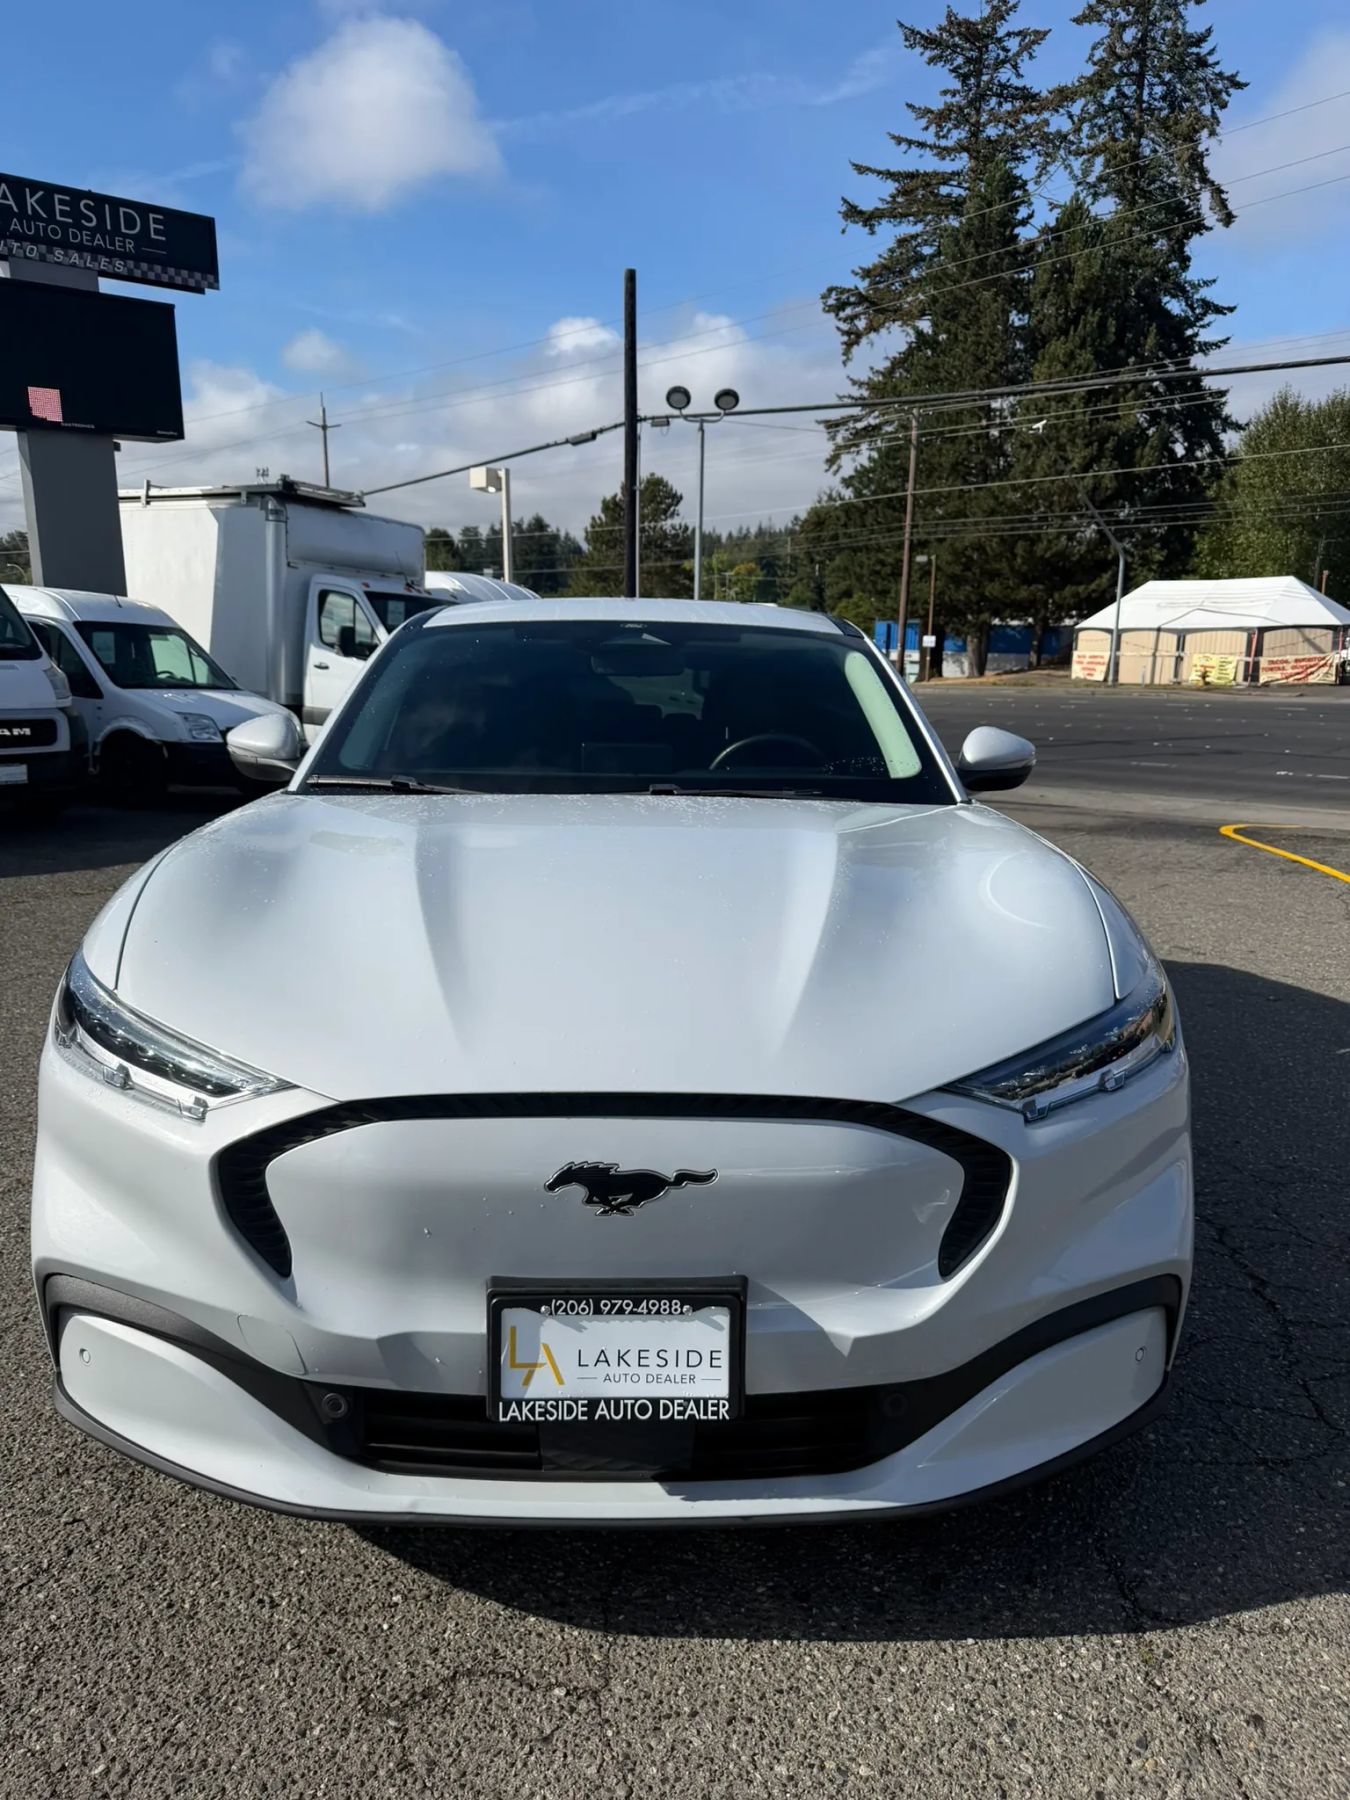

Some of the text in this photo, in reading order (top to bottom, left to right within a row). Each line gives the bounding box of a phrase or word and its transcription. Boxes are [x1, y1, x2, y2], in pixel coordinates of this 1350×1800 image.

[9, 217, 136, 254] AUTO DEALER
[54, 249, 125, 273] SALES
[551, 1299, 682, 1316] (206) 979-4988
[577, 1349, 722, 1368] LAKESIDE
[603, 1373, 696, 1385] AUTO DEALER
[499, 1399, 730, 1422] LAKESIDE AUTO DEALER
